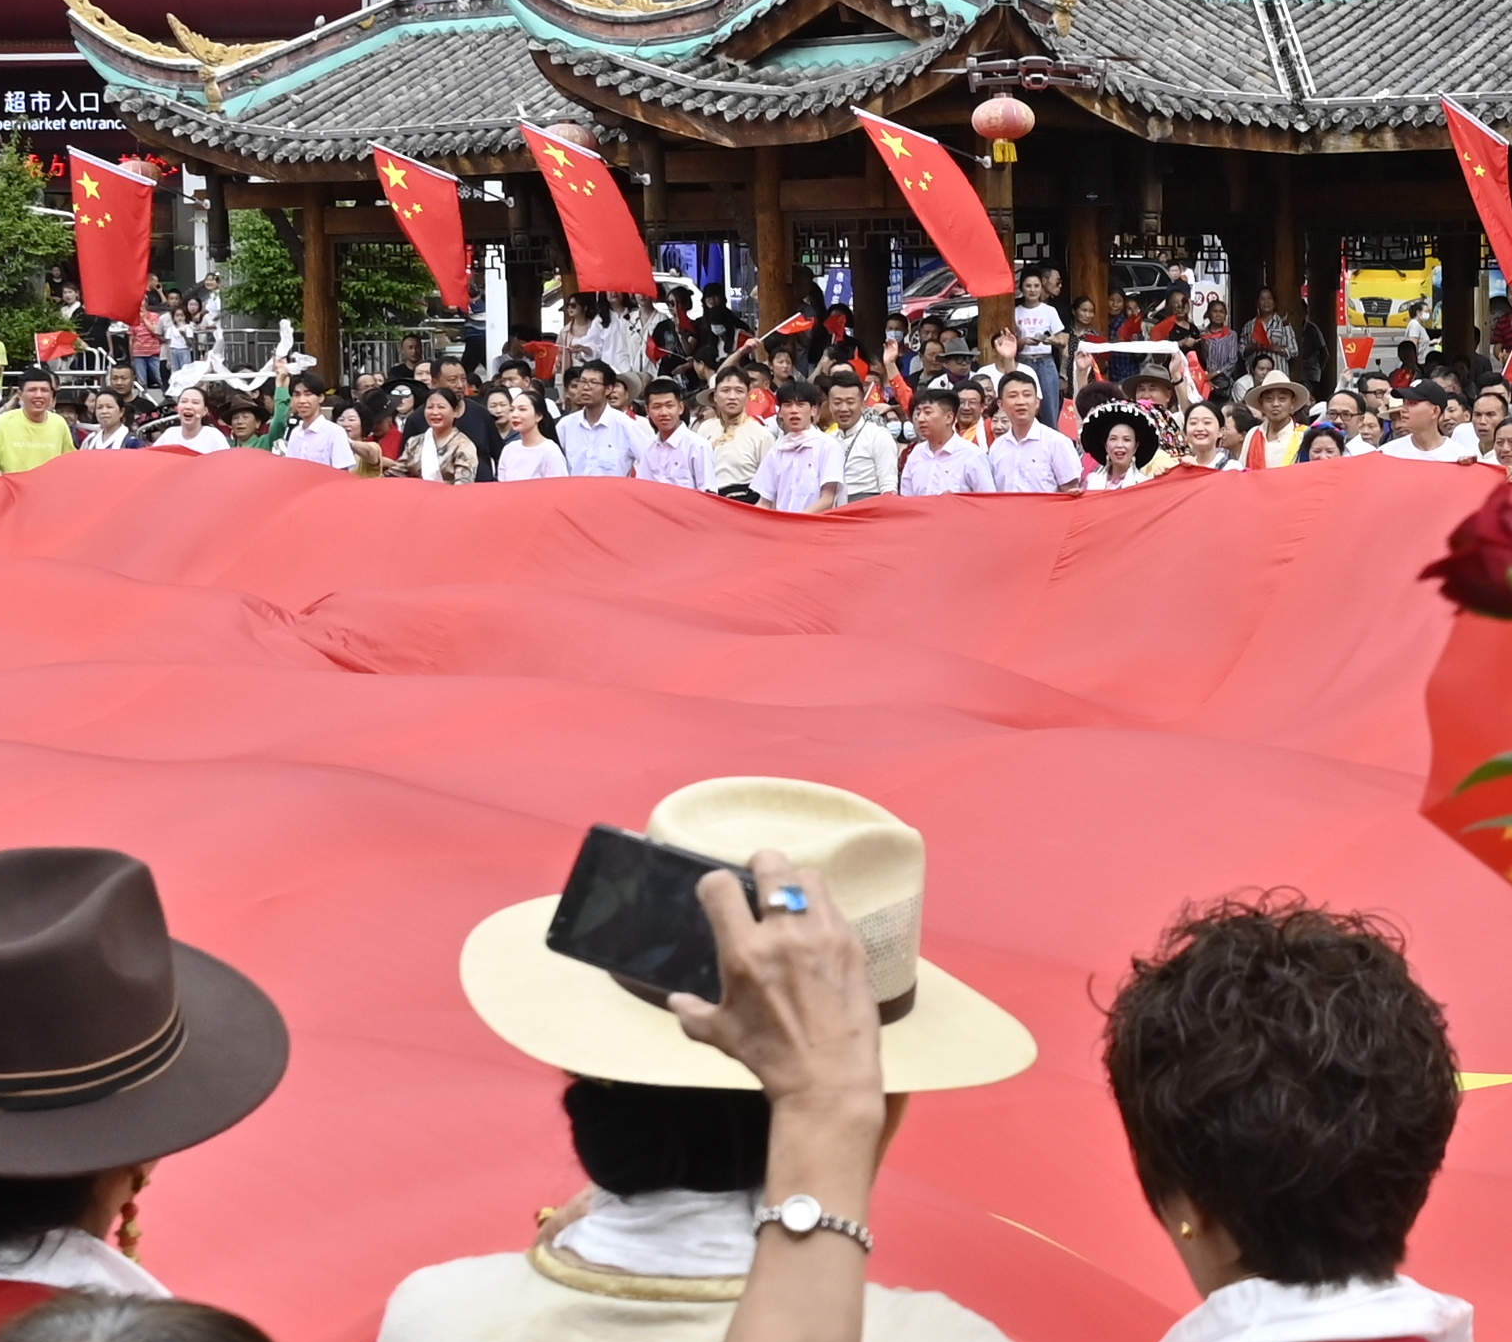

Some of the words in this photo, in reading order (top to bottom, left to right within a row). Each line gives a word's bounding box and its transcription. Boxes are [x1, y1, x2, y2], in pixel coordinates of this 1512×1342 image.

[4, 90, 100, 114] 超市入口
[70, 115, 127, 131] entranc
